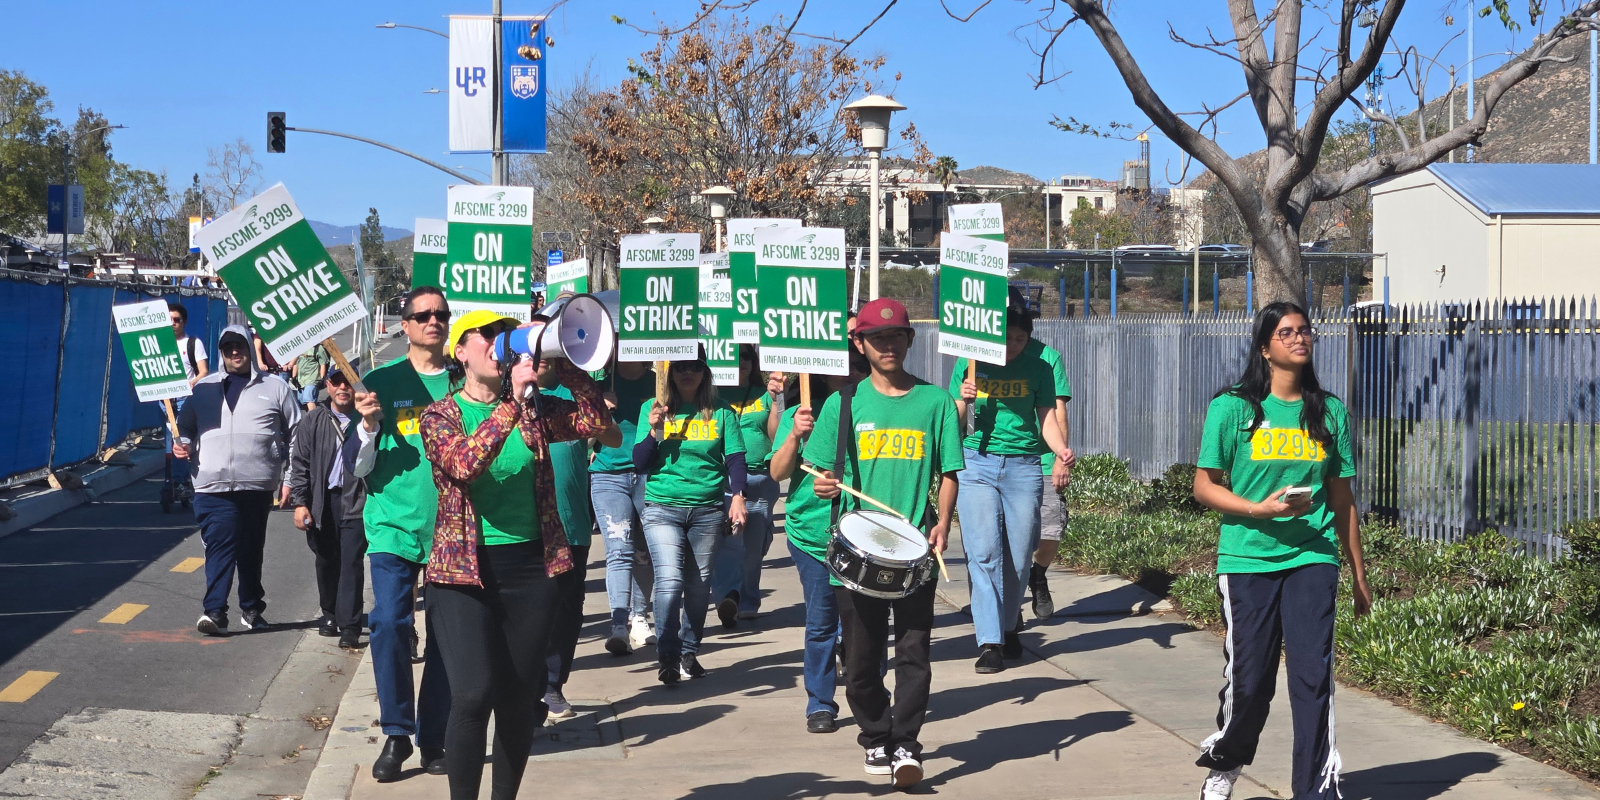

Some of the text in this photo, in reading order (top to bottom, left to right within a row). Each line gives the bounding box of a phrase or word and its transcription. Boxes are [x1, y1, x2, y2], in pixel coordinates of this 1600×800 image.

[456, 66, 486, 97] UCR
[454, 202, 527, 217] AFSCME 3299
[212, 222, 261, 260] AFSCME
[259, 204, 293, 230] 3299
[954, 218, 1000, 230] AFSCME 3299
[421, 234, 446, 247] AFSC
[474, 233, 502, 261] ON
[762, 244, 839, 261] AFSCME 3299
[255, 245, 297, 286] ON
[626, 249, 694, 261] AFSCME 3299
[946, 248, 1003, 269] AFSCME 3299
[452, 263, 526, 294] STRIKE
[550, 271, 569, 280] AFSCME
[252, 261, 342, 330] STRIKE
[646, 277, 672, 302] ON
[714, 292, 731, 302] 329
[786, 276, 816, 306] ON
[962, 277, 985, 305] ON
[120, 312, 166, 328] AFSCME 3299
[277, 302, 359, 357] UNFAIR LABOR PRACTICE
[624, 305, 693, 331] STRIKE
[764, 309, 842, 341] STRIKE
[944, 301, 1003, 336] STRIKE
[139, 334, 160, 356] ON
[645, 346, 664, 354] LABOR
[666, 346, 693, 354] PRACTICE
[942, 340, 1003, 359] UNFAIR LABOR PRACTICE
[132, 354, 182, 380] STRIKE
[764, 355, 844, 368] UNFAIR LABOR PRACTICE
[155, 388, 168, 396] LABOR
[168, 385, 188, 394] PRACTICE
[982, 380, 1021, 396] 3299
[868, 433, 916, 458] 3299
[1261, 432, 1317, 459] 3299
